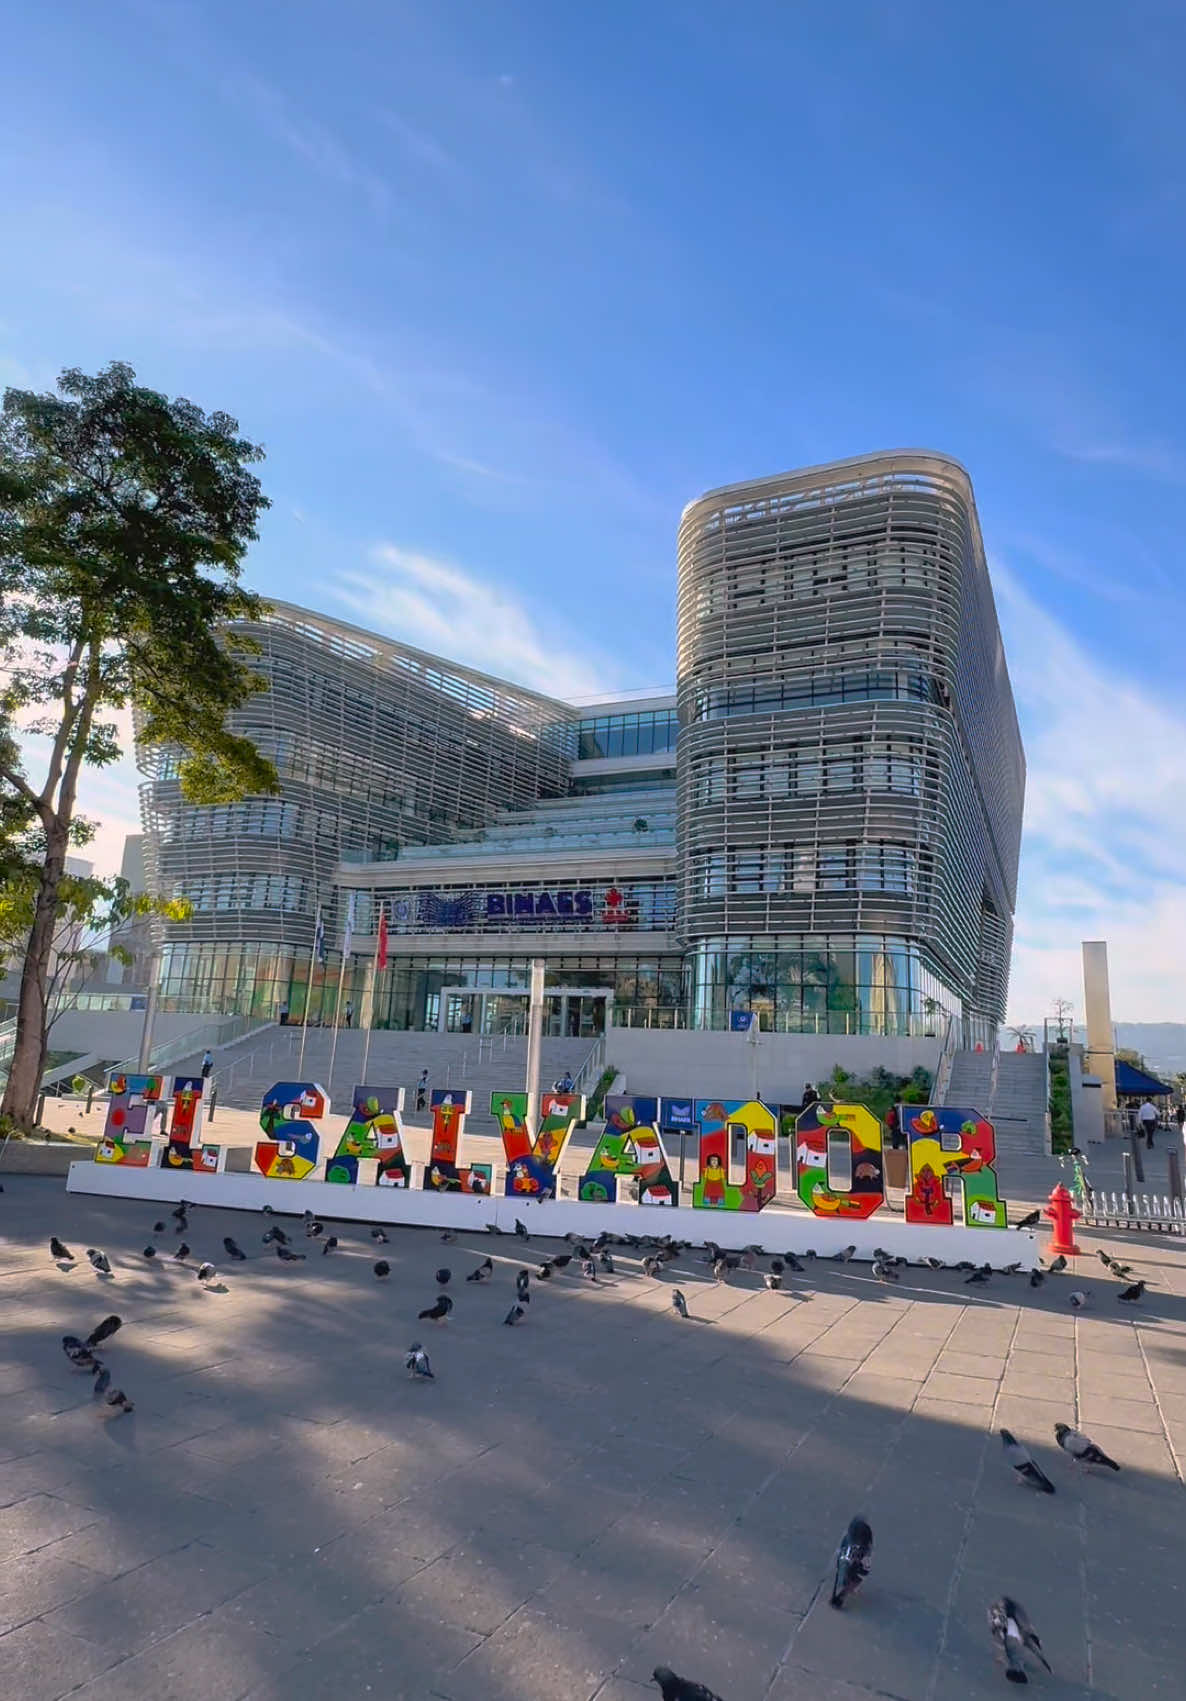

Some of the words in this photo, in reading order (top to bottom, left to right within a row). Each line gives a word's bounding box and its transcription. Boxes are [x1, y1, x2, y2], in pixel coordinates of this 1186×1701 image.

[487, 890, 593, 916] BINAES
[95, 1073, 223, 1174] EL
[254, 1082, 1008, 1228] SALVADOR
